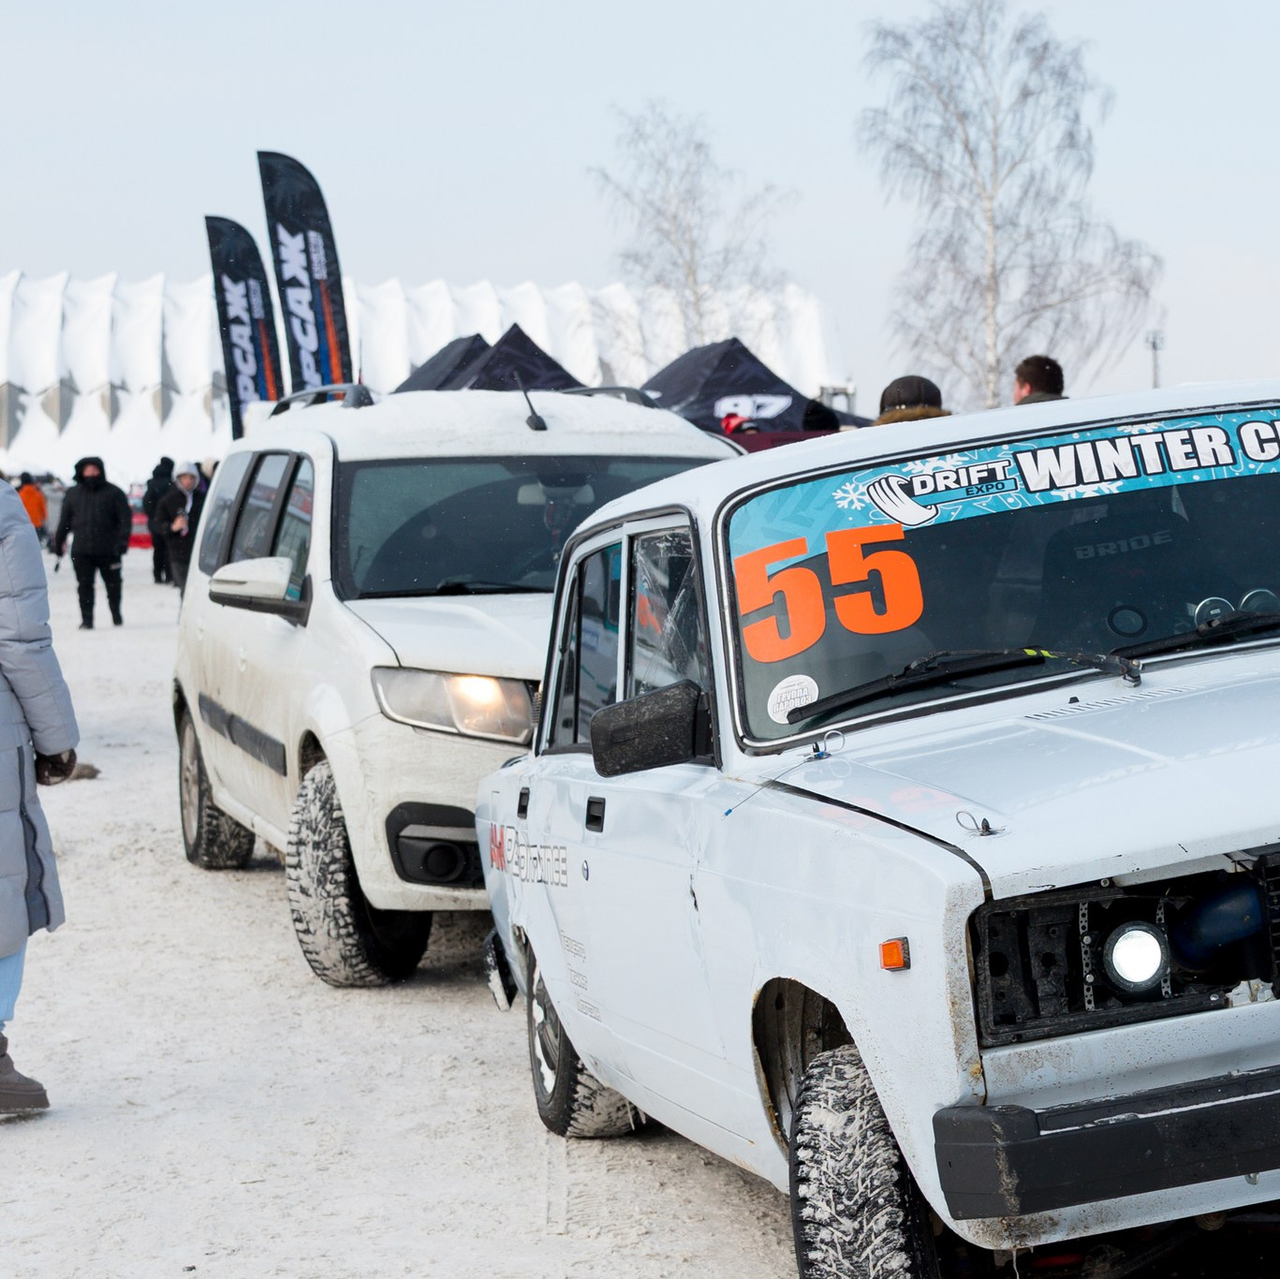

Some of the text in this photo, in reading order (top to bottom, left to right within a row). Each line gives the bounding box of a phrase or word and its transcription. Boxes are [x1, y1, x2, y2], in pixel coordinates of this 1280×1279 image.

[276, 222, 322, 390] РСАЖ
[221, 273, 260, 405] РСАЖ
[911, 460, 1010, 496] DRIFT
[1014, 426, 1236, 493] WINTER
[965, 482, 1006, 497] EXPO
[1073, 530, 1172, 560] BRIDE
[734, 523, 924, 663] 55
[777, 687, 809, 703] ГРУППА
